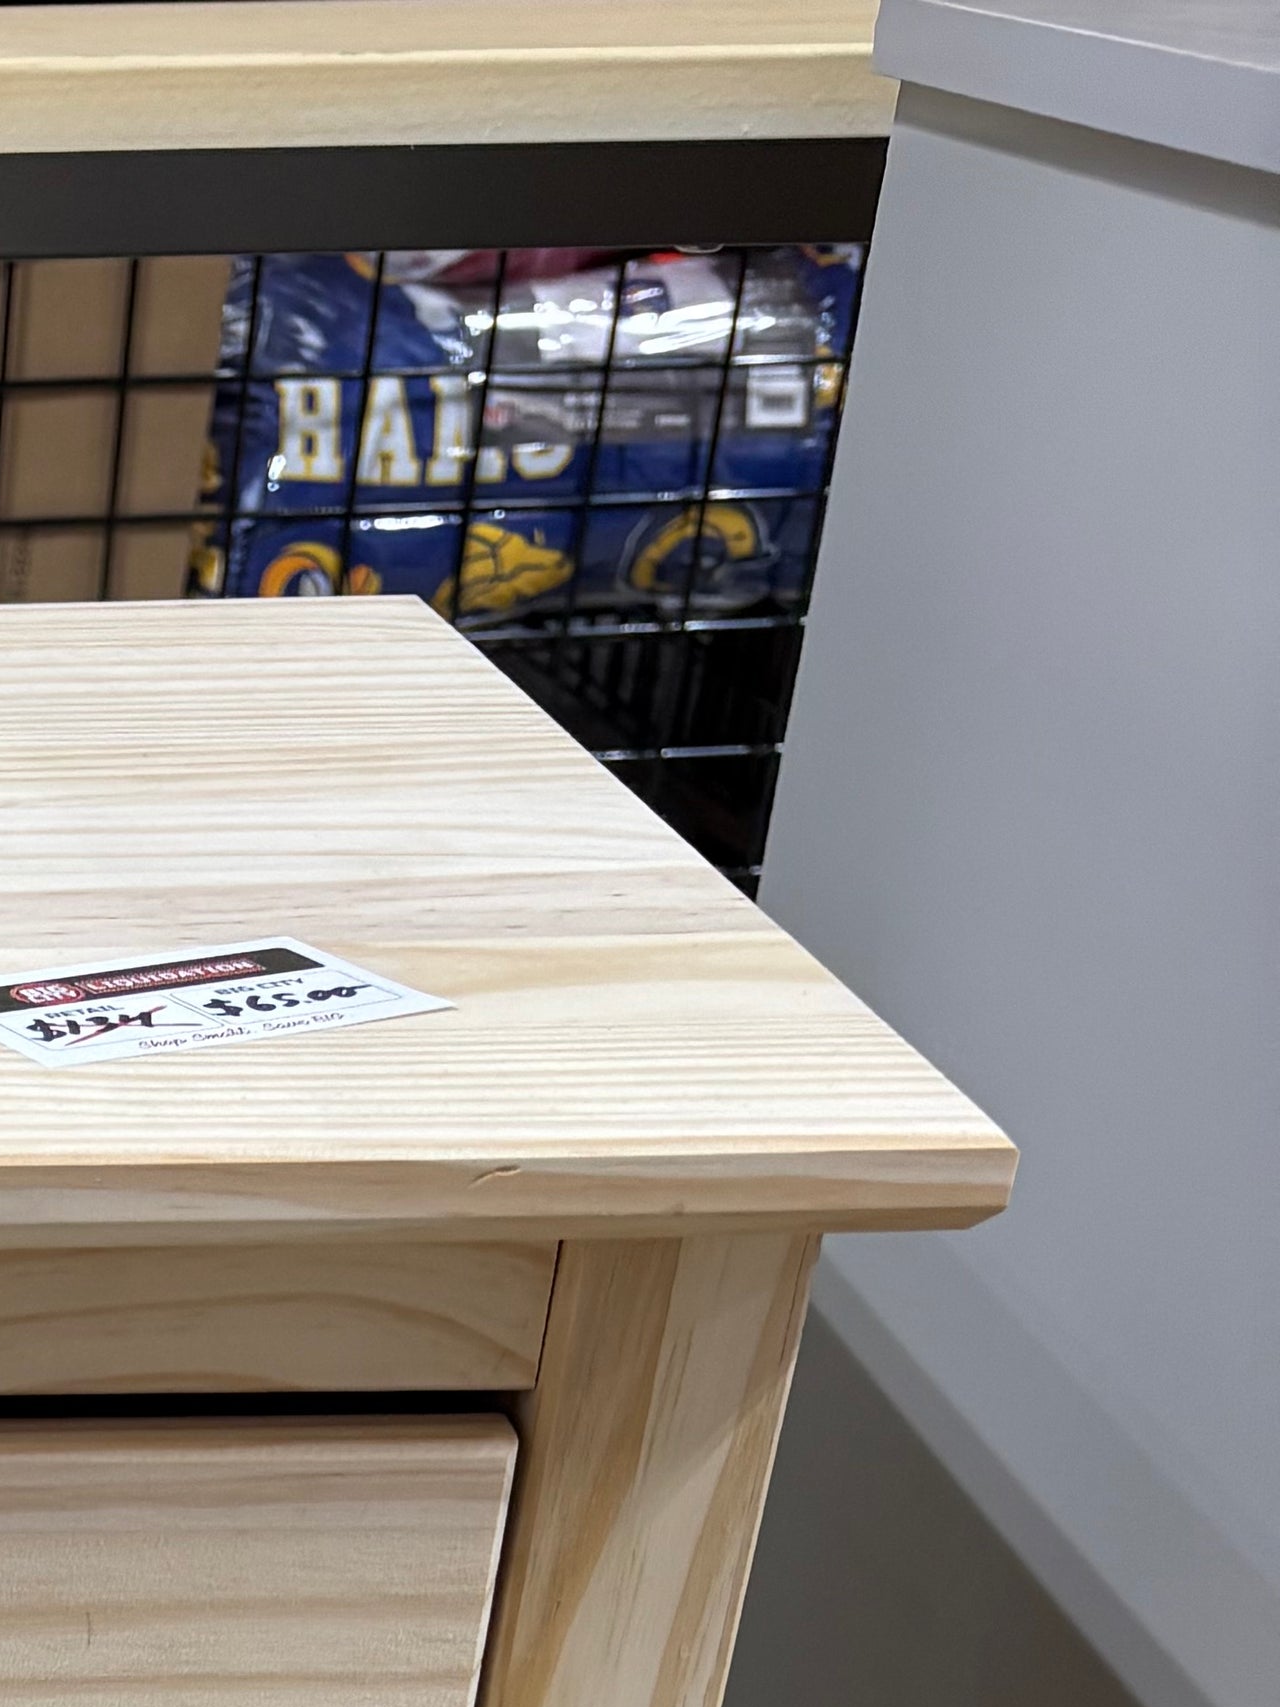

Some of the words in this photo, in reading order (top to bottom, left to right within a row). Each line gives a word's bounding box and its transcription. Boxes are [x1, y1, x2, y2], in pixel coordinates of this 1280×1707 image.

[87, 959, 255, 991] LIQUIDATION
[214, 985, 256, 997] BIG
[256, 977, 305, 991] CITY
[45, 1004, 124, 1019] RETAIL
